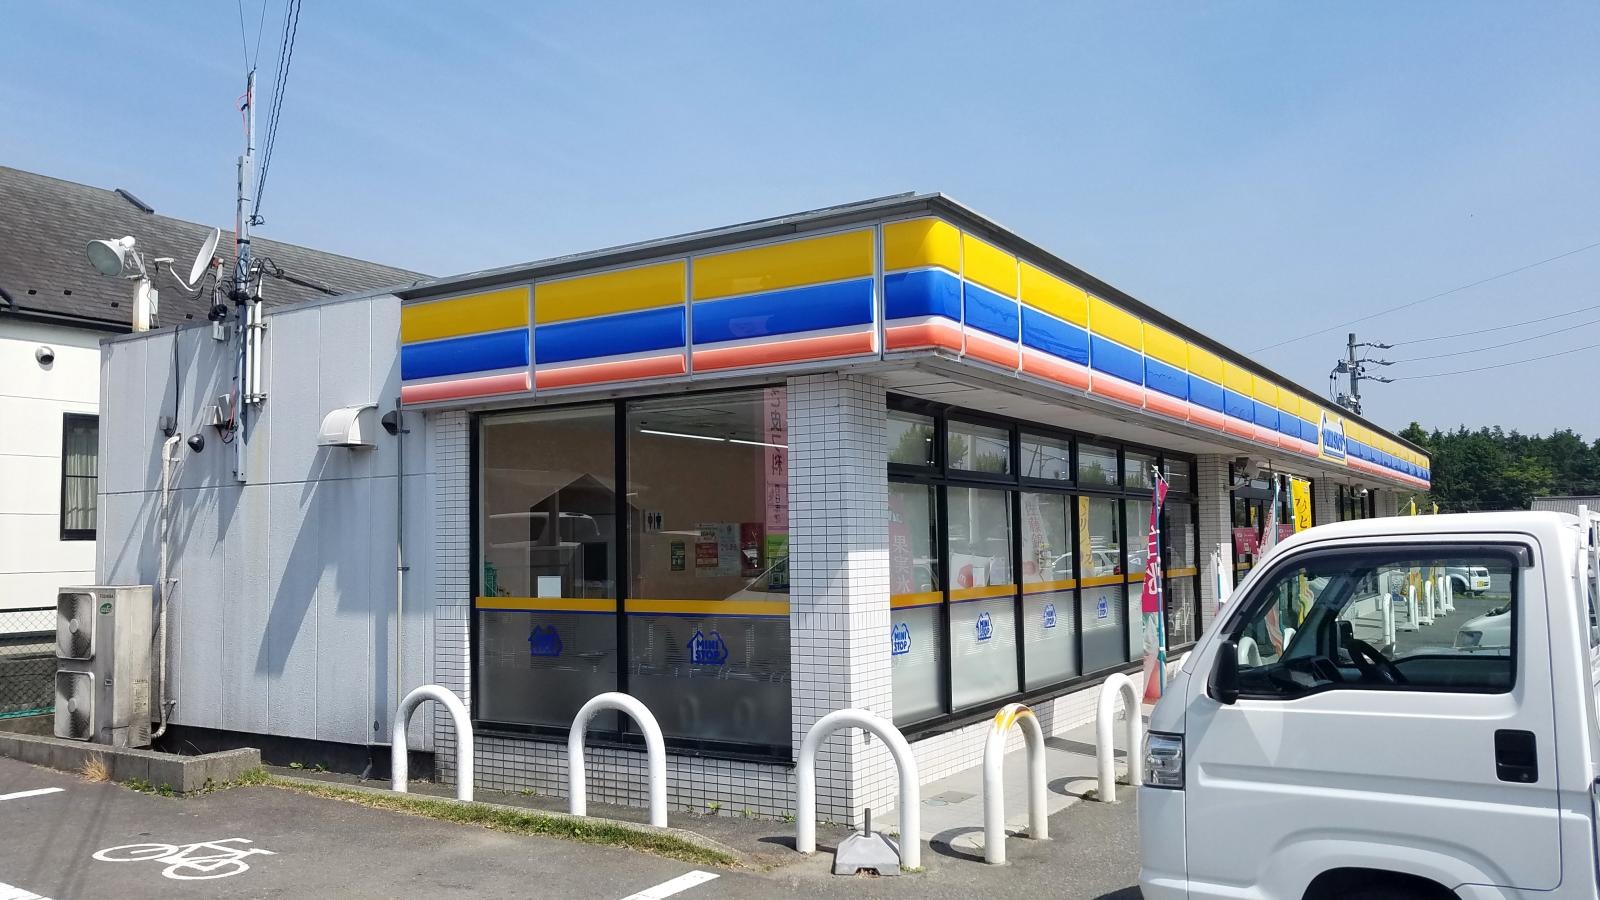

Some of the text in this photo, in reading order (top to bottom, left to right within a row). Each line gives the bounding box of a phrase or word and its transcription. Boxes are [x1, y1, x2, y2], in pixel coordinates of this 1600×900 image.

[894, 630, 907, 641] MINI
[696, 639, 719, 650] MINI
[893, 641, 908, 651] STOP
[695, 650, 720, 661] STOP
